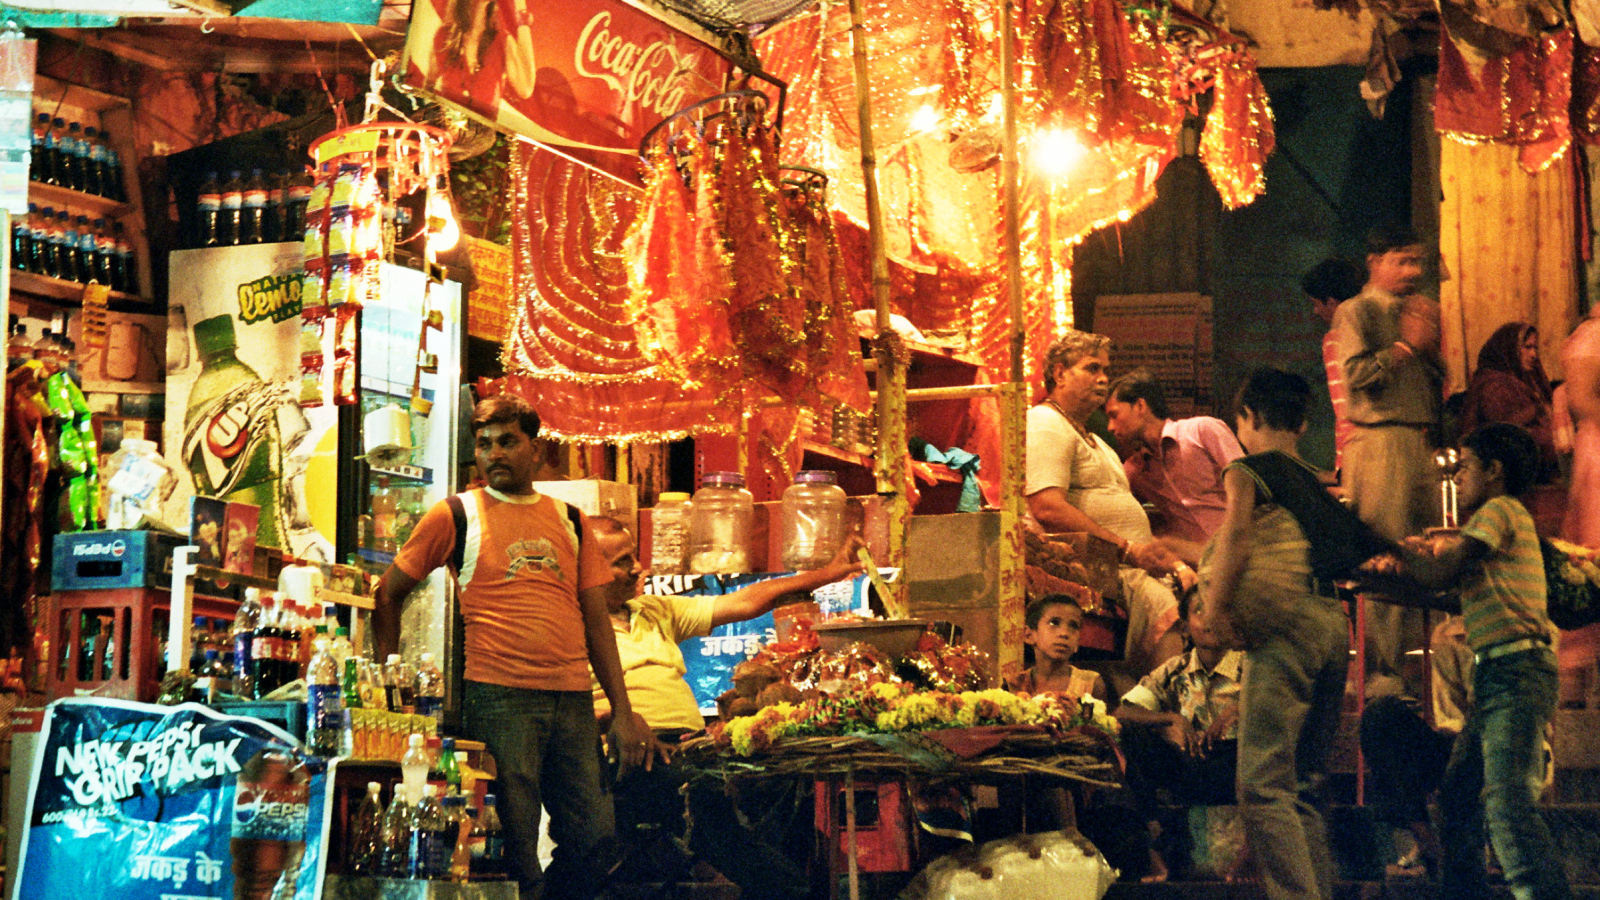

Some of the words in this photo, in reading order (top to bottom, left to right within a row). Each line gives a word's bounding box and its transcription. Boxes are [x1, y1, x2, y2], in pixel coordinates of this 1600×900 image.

[575, 11, 686, 119] Coca-Cola
[73, 543, 111, 556] PEPSI
[55, 739, 123, 776] NEW
[126, 721, 206, 768] PEPSI
[72, 762, 145, 806] GRIP
[152, 738, 241, 790] PACK
[130, 855, 190, 889] जकड़
[195, 851, 223, 884] के
